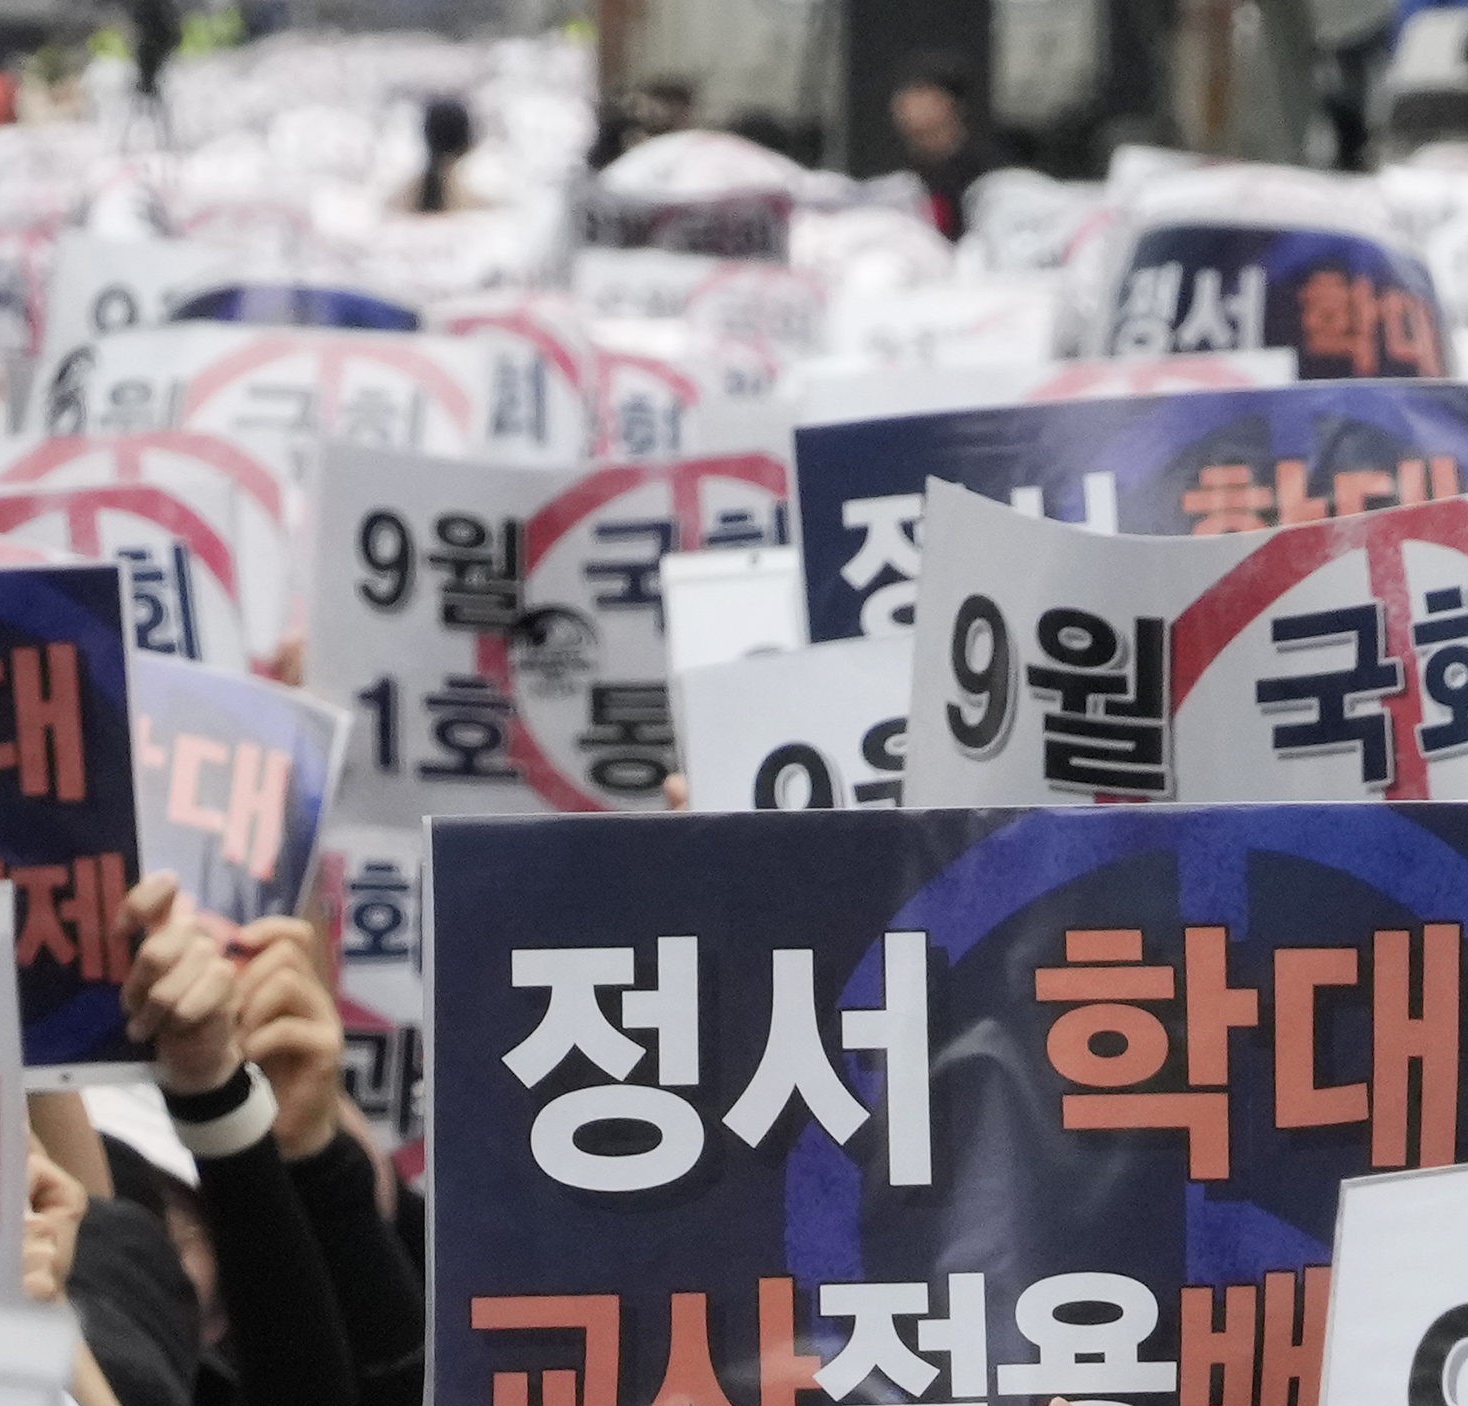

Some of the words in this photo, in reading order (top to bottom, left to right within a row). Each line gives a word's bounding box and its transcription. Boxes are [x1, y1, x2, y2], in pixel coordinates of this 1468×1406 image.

[358, 507, 525, 630] 9월
[359, 672, 521, 782] 1호
[946, 593, 1176, 795] 9월
[140, 712, 293, 882] 대
[501, 930, 933, 1191] 정서
[1034, 923, 1459, 1181] 학대
